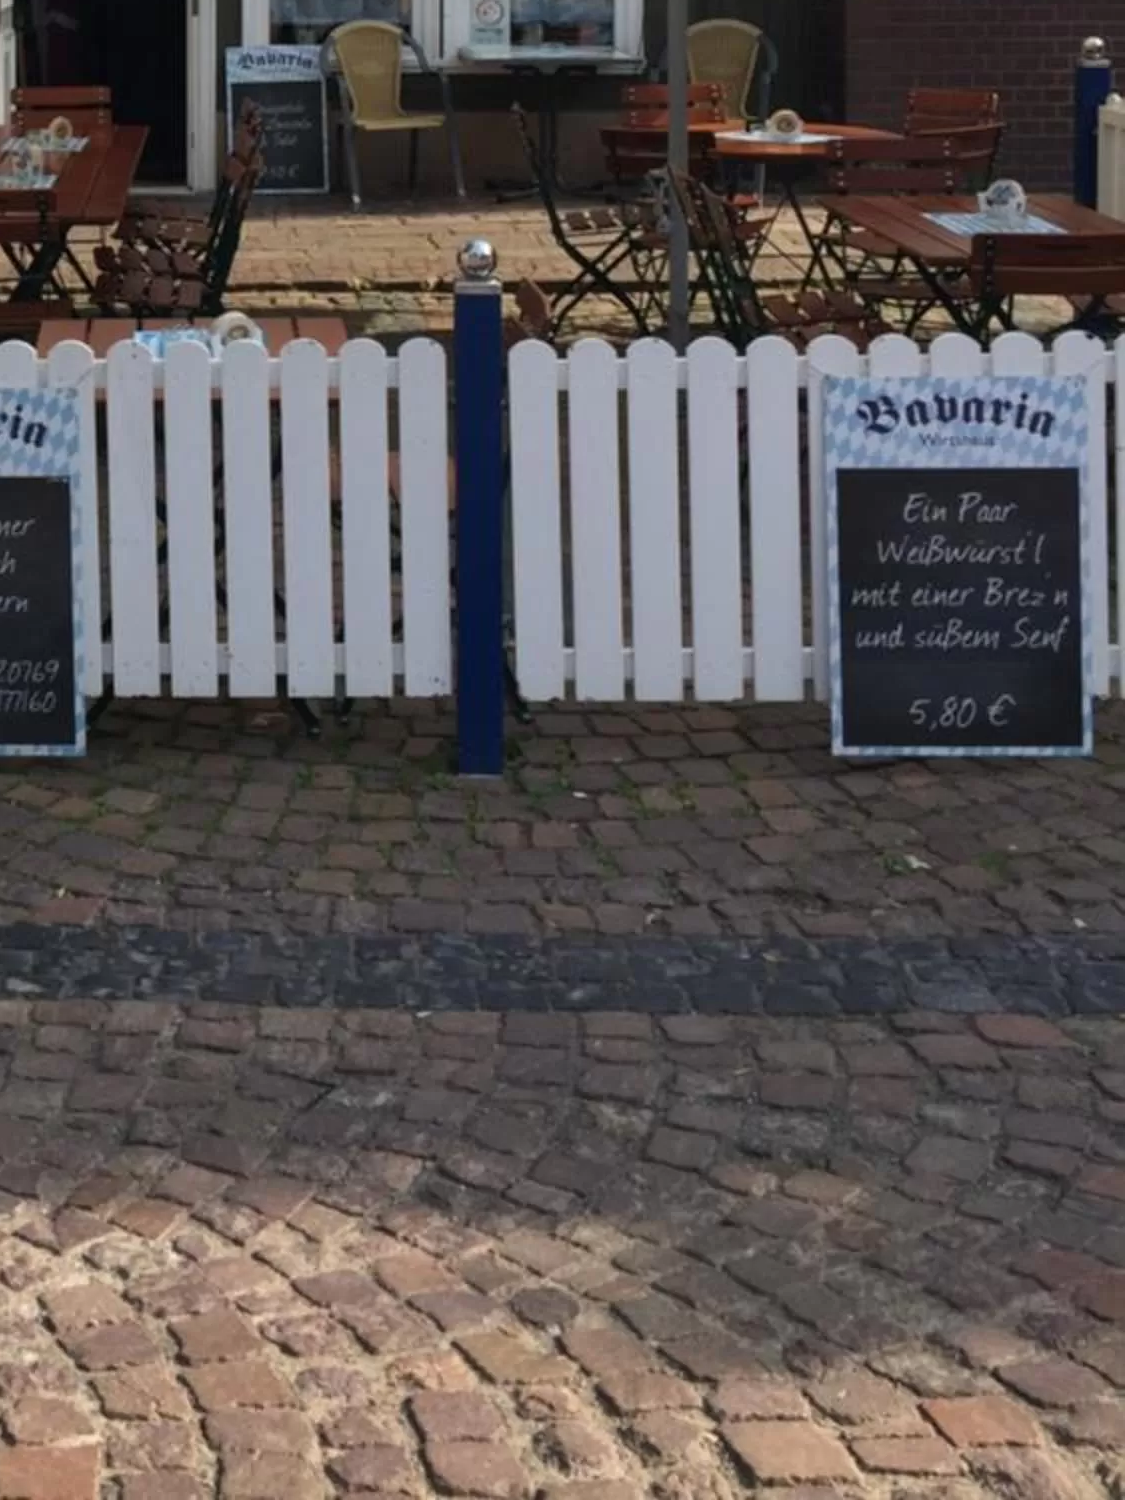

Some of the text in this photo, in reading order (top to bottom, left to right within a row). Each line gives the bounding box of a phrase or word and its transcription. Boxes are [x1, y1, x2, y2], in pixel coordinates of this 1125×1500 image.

[237, 51, 313, 70] Bavaria
[855, 392, 1056, 438] Bavaria
[903, 492, 1019, 523] Ein Paar
[851, 580, 901, 607] mit
[911, 581, 976, 607] einer
[856, 615, 1070, 653] und süßem Senf
[908, 693, 1017, 732] 5,80 €
